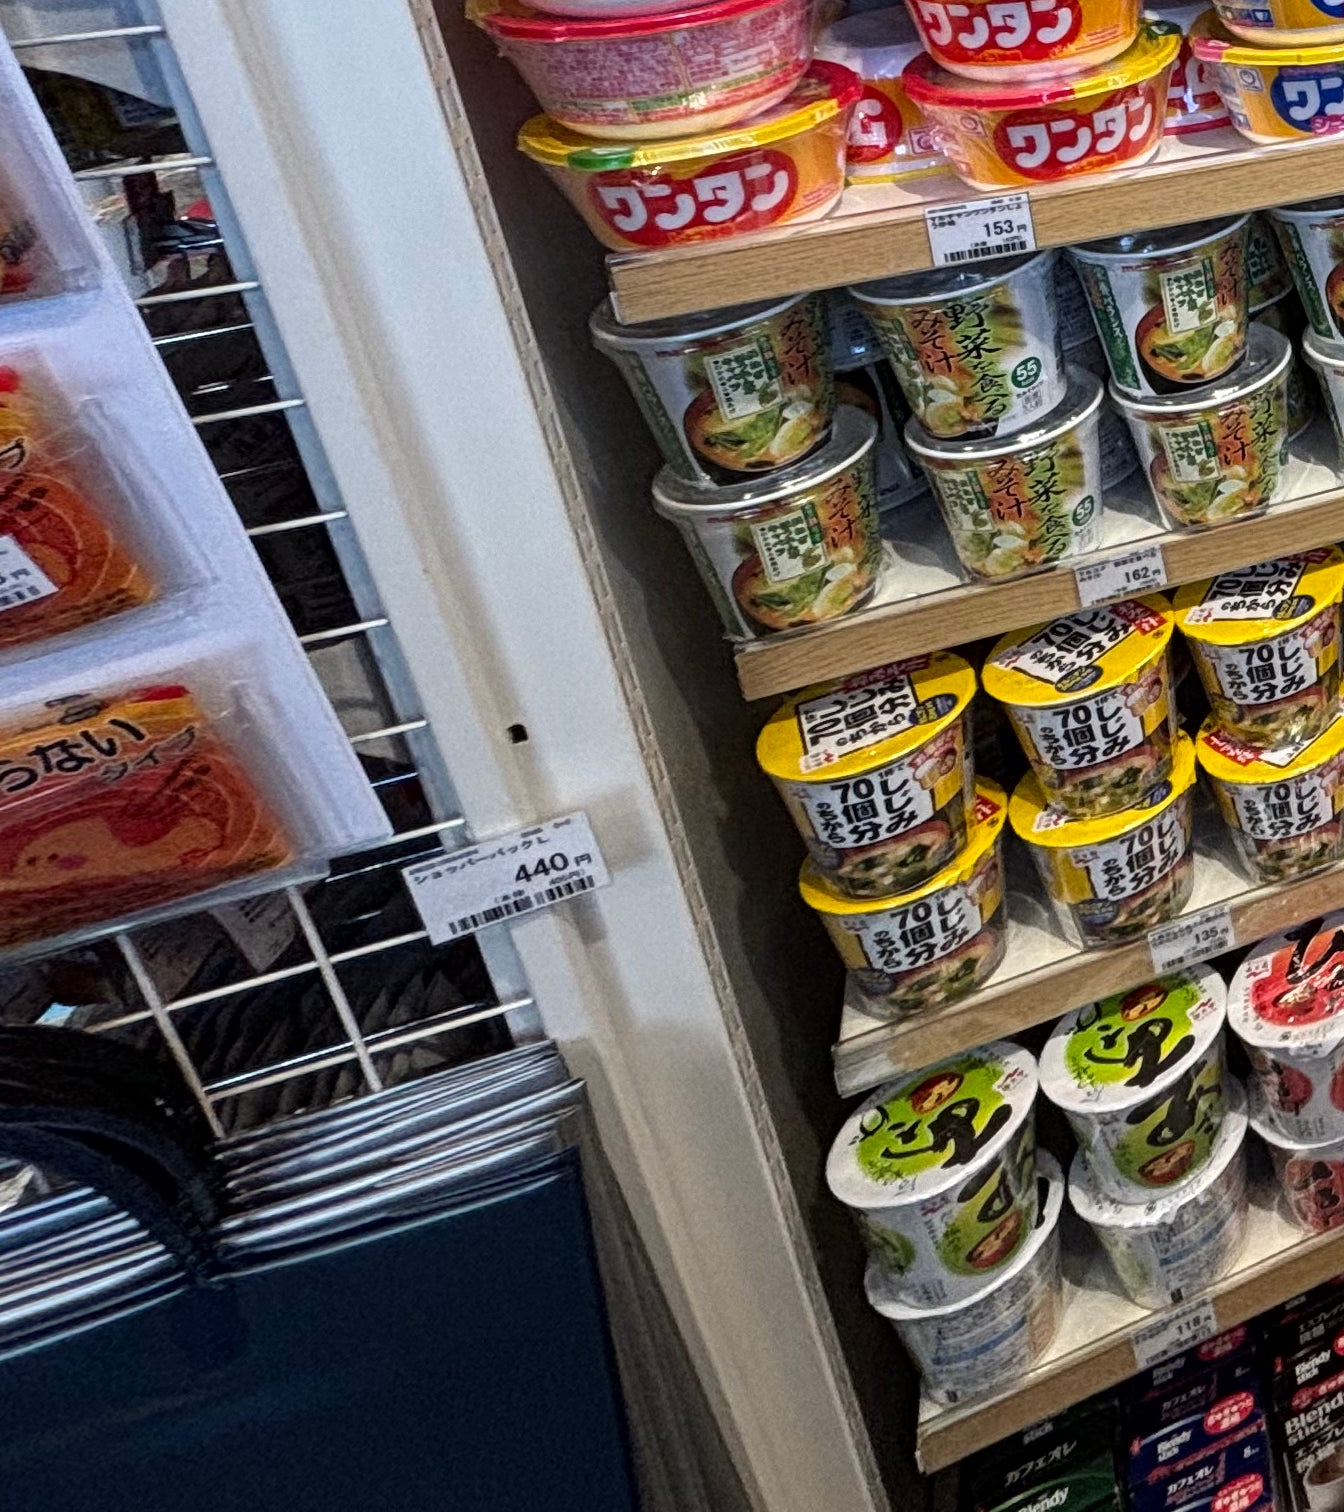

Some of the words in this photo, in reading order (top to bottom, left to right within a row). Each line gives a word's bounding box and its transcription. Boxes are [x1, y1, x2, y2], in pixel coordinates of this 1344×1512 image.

[1008, 100, 1151, 169] ワンタン
[599, 162, 789, 233] ワンタン
[913, 304, 958, 374] みそ汁
[1015, 363, 1038, 382] 55
[1239, 645, 1282, 703] 70個分
[1276, 640, 1308, 694] しじみ
[1052, 705, 1101, 767] 70個分
[1096, 693, 1131, 755] しじみ
[817, 802, 845, 844] のちから
[831, 778, 884, 844] 70個分
[881, 778, 918, 833] しじみ
[890, 902, 937, 964] 70個分
[937, 896, 969, 952] しじみ
[1295, 1350, 1331, 1375] Blendy
[1004, 1440, 1077, 1487] カフェオレ
[1167, 1463, 1215, 1496] カフェオレ
